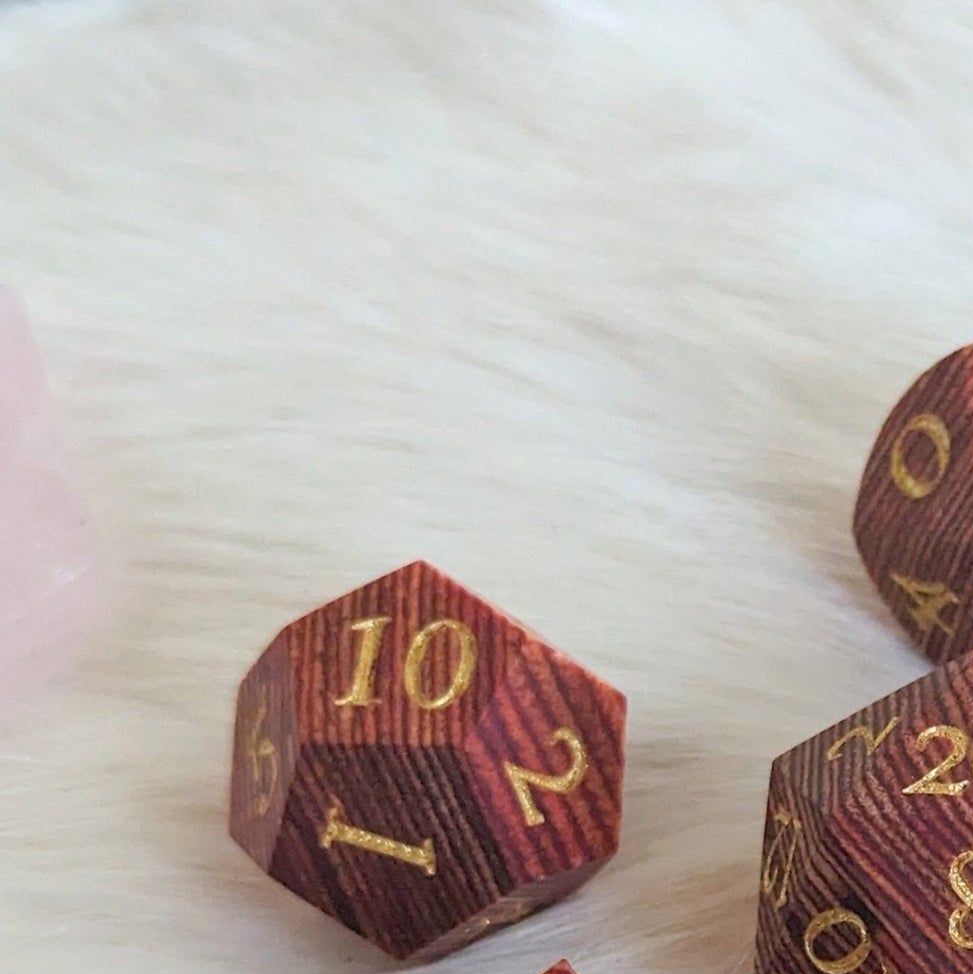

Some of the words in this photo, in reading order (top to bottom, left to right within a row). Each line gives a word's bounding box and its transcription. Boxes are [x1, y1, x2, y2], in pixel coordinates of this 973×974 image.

[890, 414, 951, 499] 0
[890, 571, 961, 637] 4
[334, 616, 478, 710] 10
[504, 727, 590, 826] 2
[827, 717, 900, 761] 2
[319, 803, 436, 876] 1
